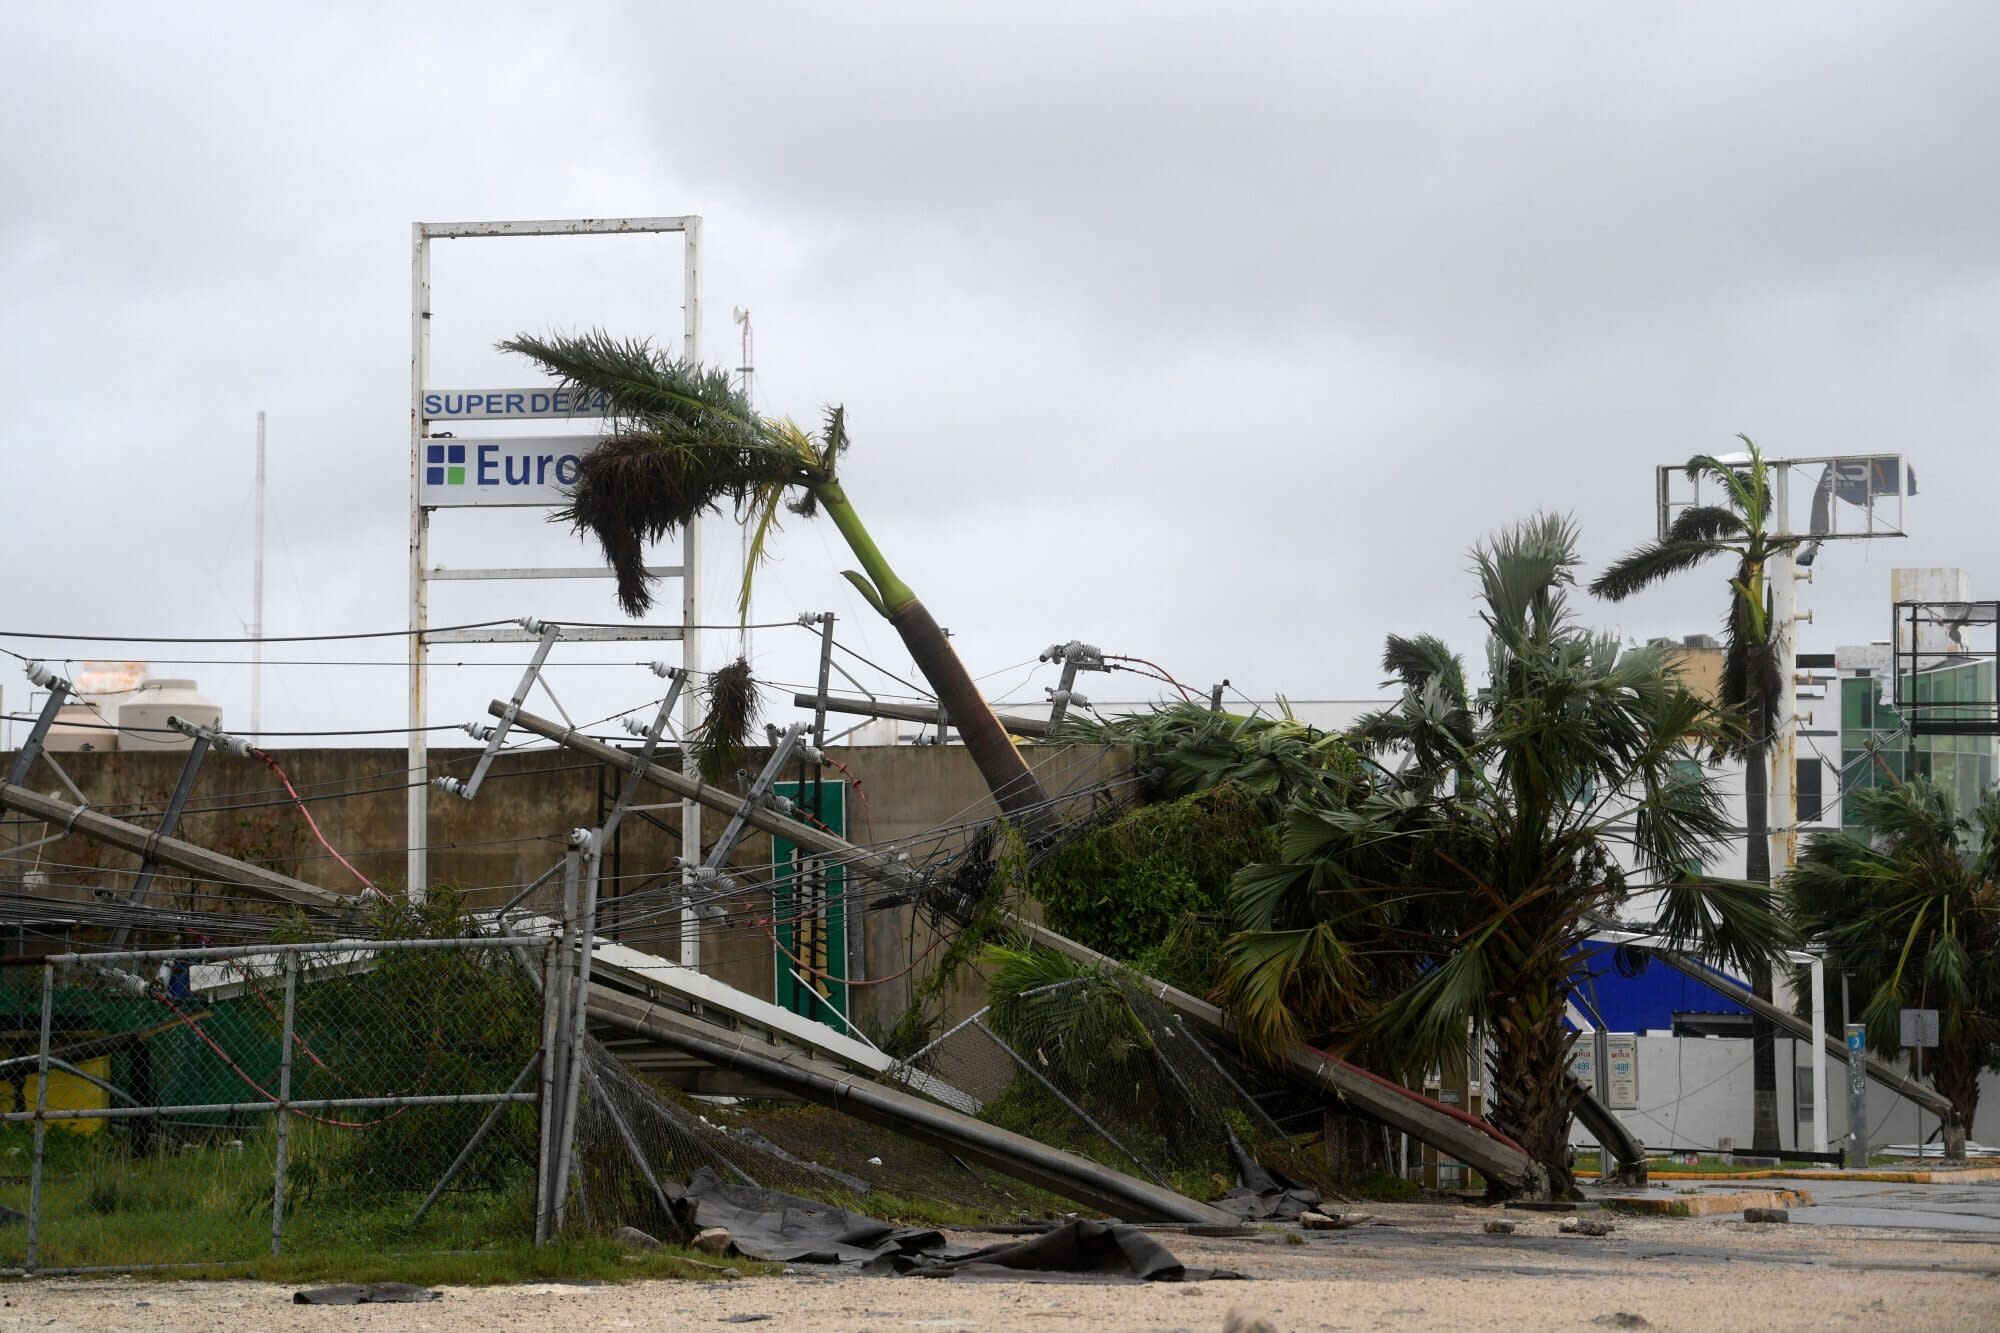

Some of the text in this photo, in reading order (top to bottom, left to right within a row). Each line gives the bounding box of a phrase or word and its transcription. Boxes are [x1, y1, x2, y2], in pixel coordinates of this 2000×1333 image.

[424, 393, 525, 414] SUPER
[531, 392, 569, 413] DE
[477, 444, 580, 485] Euro
